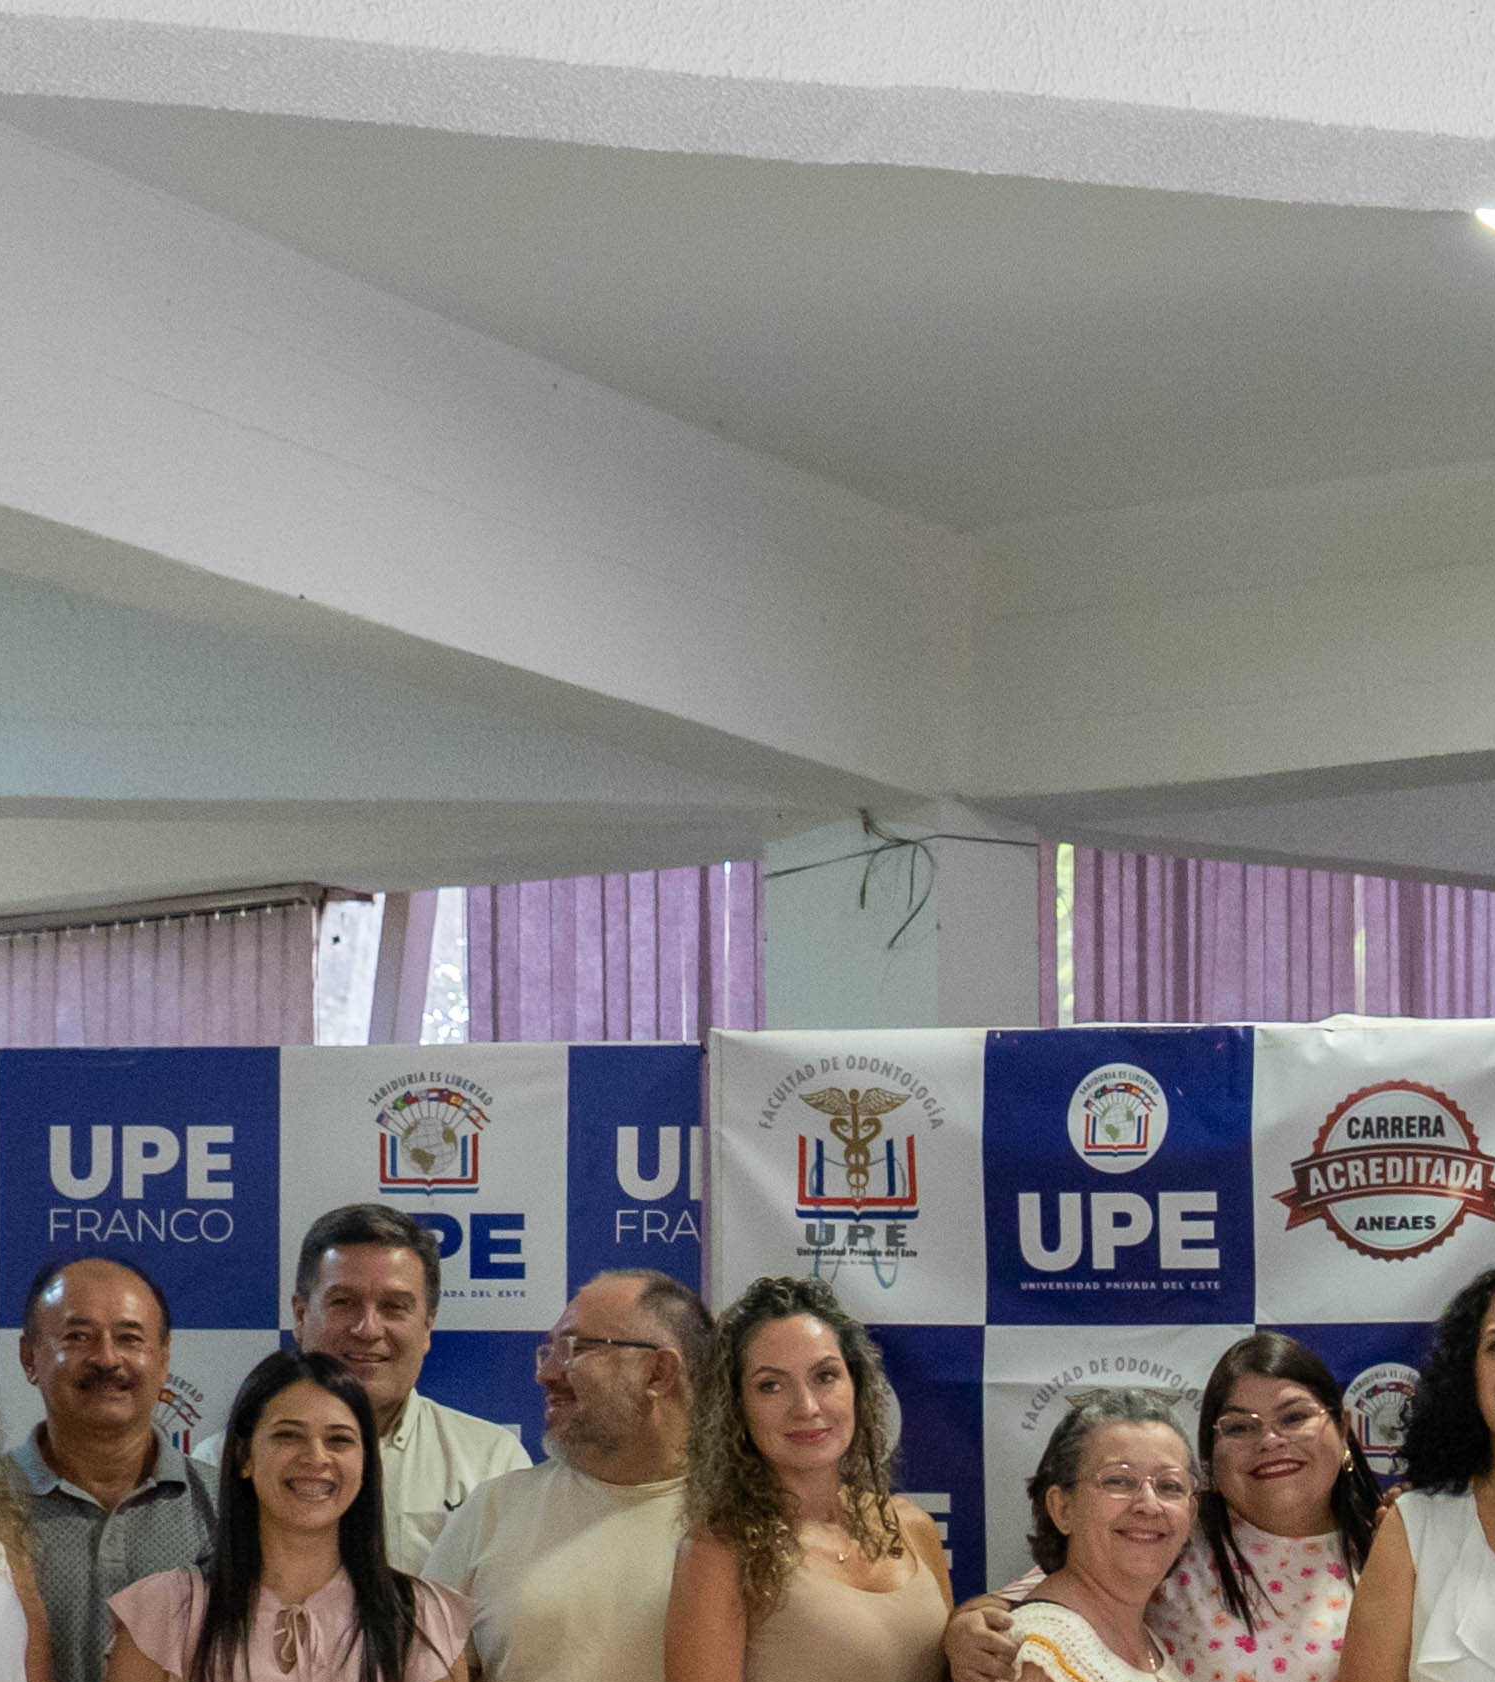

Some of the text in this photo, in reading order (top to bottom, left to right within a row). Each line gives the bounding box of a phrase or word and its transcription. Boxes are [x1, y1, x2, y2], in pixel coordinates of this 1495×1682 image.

[430, 1072, 441, 1082] ES
[758, 1063, 816, 1130] FACULTAD
[821, 1056, 840, 1073] DE
[1346, 1115, 1445, 1140] CARRERA
[48, 1125, 234, 1201] UPE
[1308, 1155, 1484, 1196] ACREDITADA
[48, 1208, 234, 1244] FRANCO
[615, 1210, 701, 1243] FRA
[806, 1224, 906, 1248] UPE
[1018, 1191, 1221, 1272] UPE
[1354, 1215, 1437, 1232] ANEAES
[406, 1213, 526, 1280] PE
[1020, 1281, 1221, 1290] UNIVERSIDAD PRIVADA DEL ESTE
[1021, 1356, 1204, 1431] FACULTAD DE ODONTOLOG
